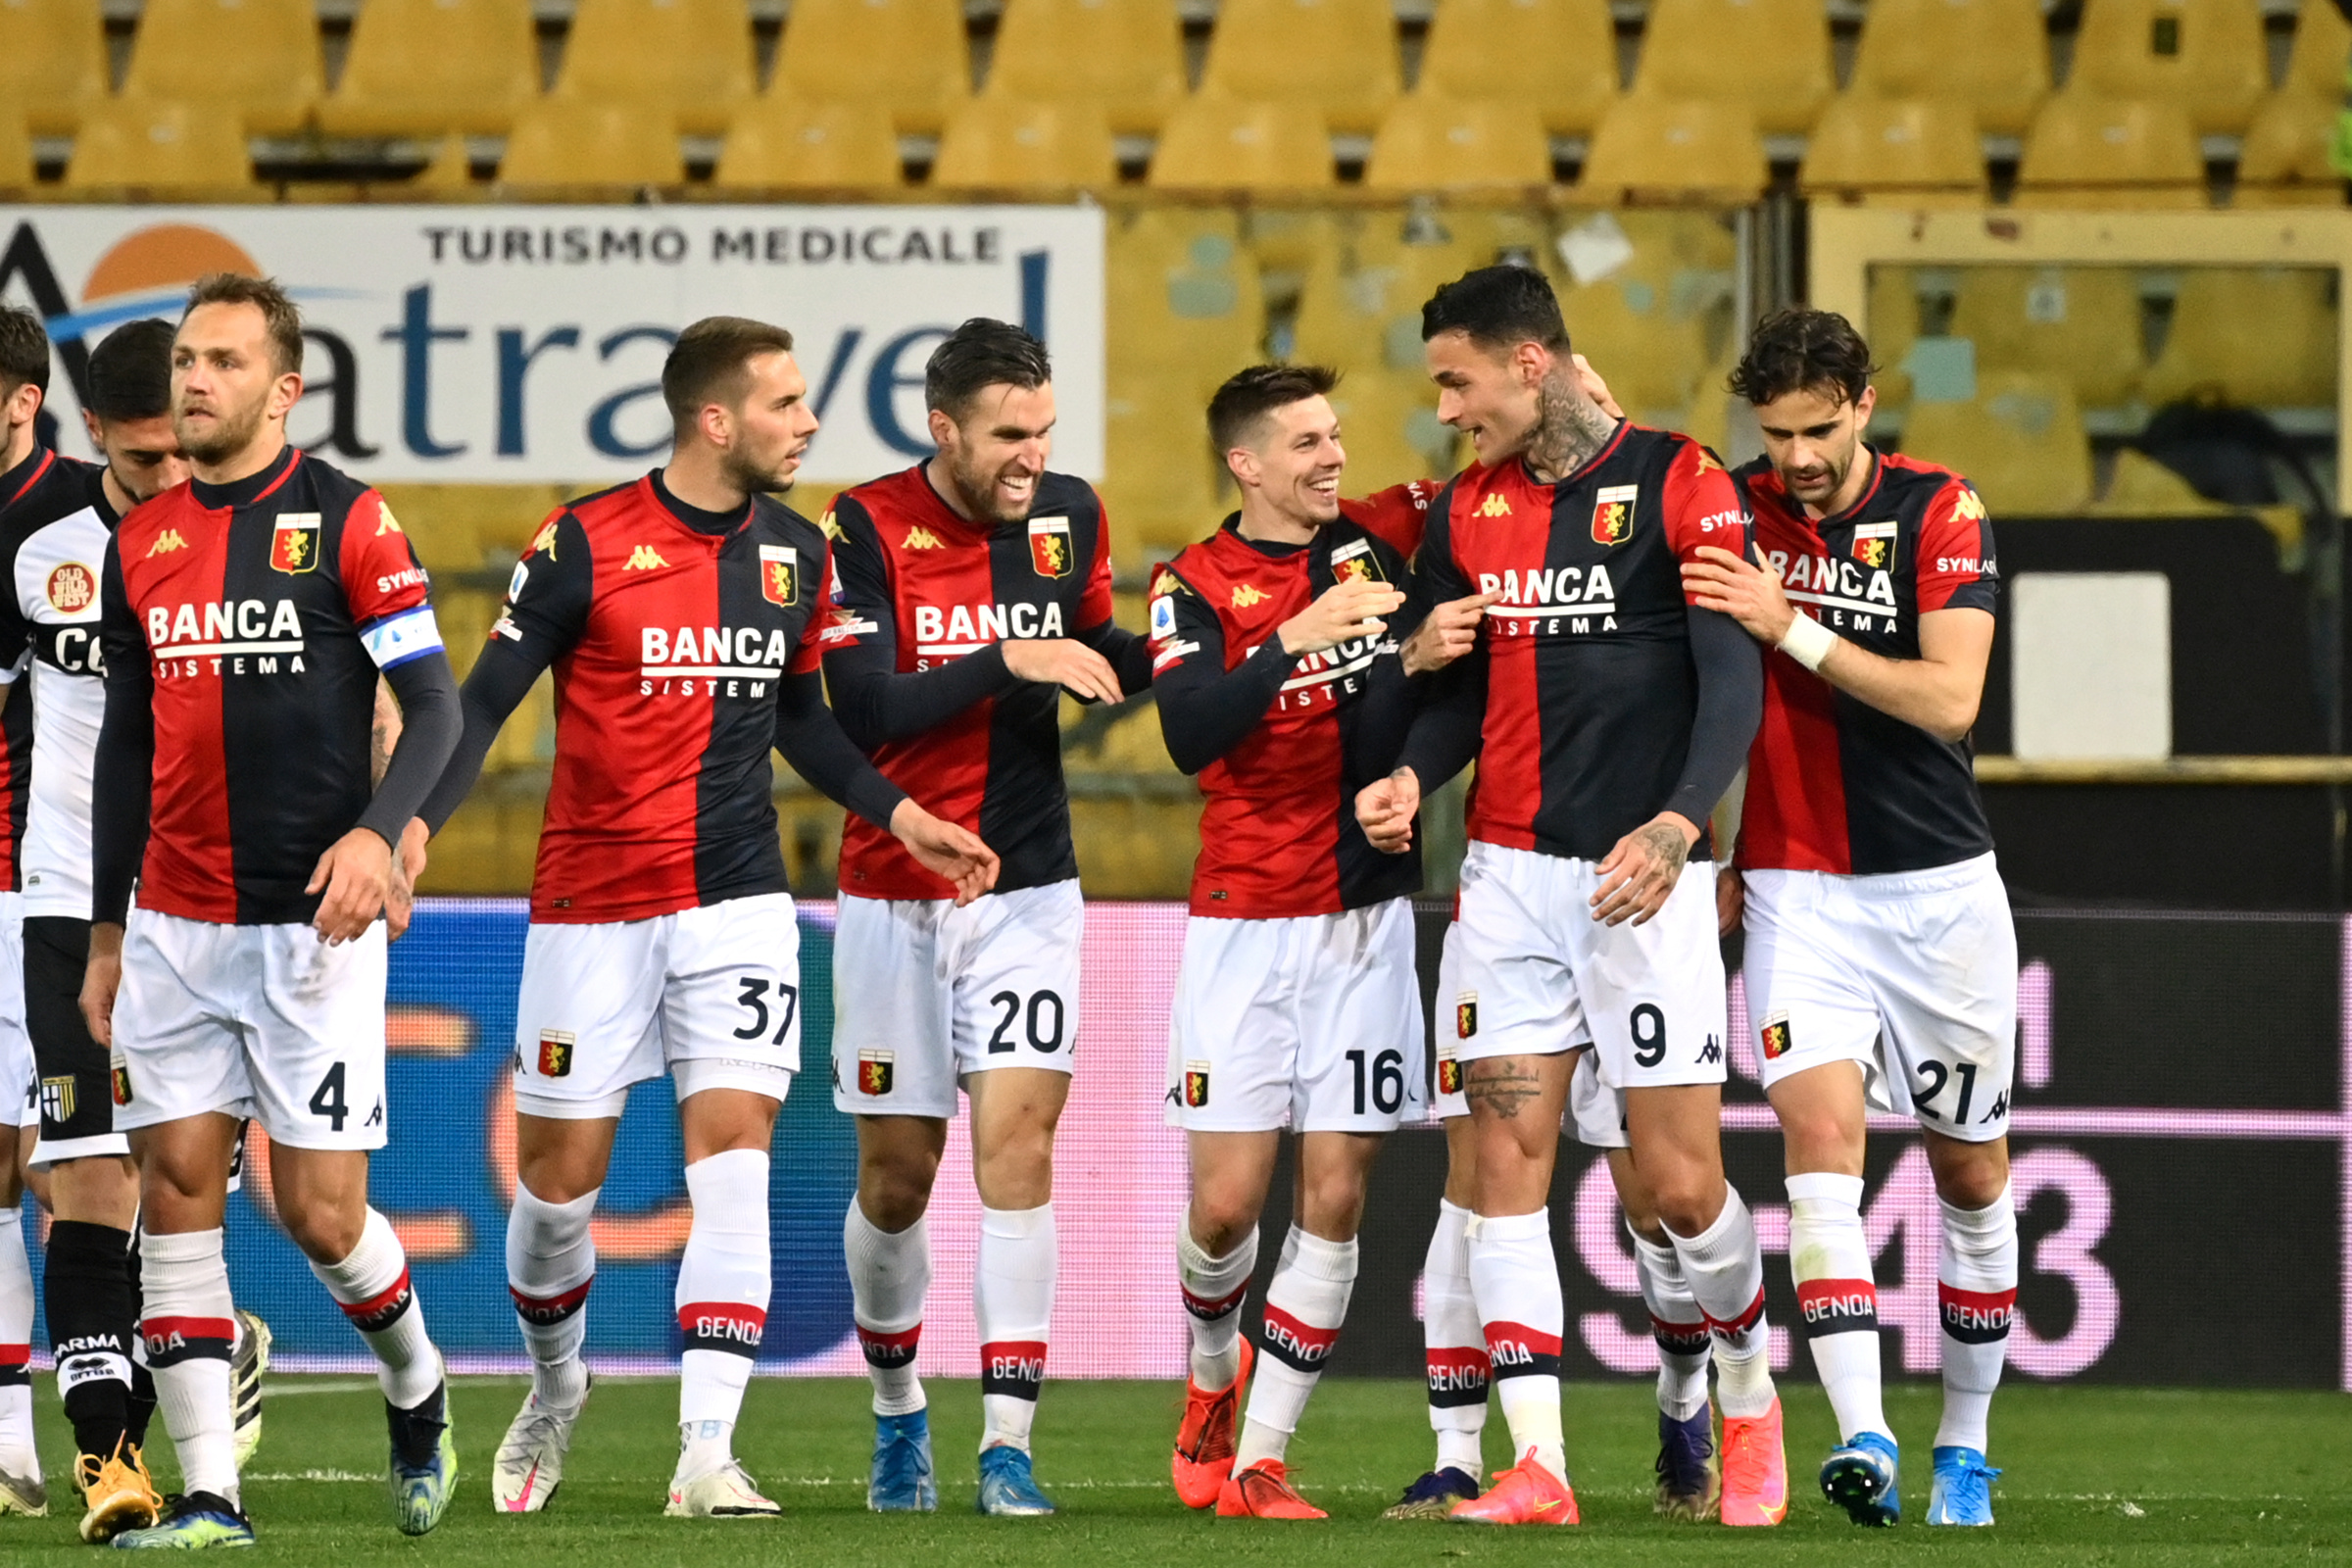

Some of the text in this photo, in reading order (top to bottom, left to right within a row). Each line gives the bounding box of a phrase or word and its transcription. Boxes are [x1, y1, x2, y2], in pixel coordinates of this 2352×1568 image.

[425, 225, 999, 264] TURISMO MEDICALE
[53, 579, 88, 595] WILD
[56, 567, 84, 581] OLD
[1768, 550, 1895, 606] BANCA
[52, 592, 89, 608] WEST
[149, 600, 302, 645] BANCA
[915, 602, 1063, 642] BANCA
[642, 627, 785, 665] BANCA
[159, 656, 306, 678] SISTEMA
[640, 680, 765, 698] SISTEM
[732, 976, 797, 1047] 37
[988, 989, 1064, 1054] 20
[1630, 1003, 1667, 1067] 9
[309, 1061, 348, 1131] 4
[1346, 1049, 1403, 1114] 16
[1911, 1059, 1977, 1125] 21
[1803, 1294, 1873, 1323] GENOA
[1947, 1301, 2014, 1330] GENOA
[697, 1316, 762, 1347] GENOA
[1428, 1364, 1485, 1393] GENOA
